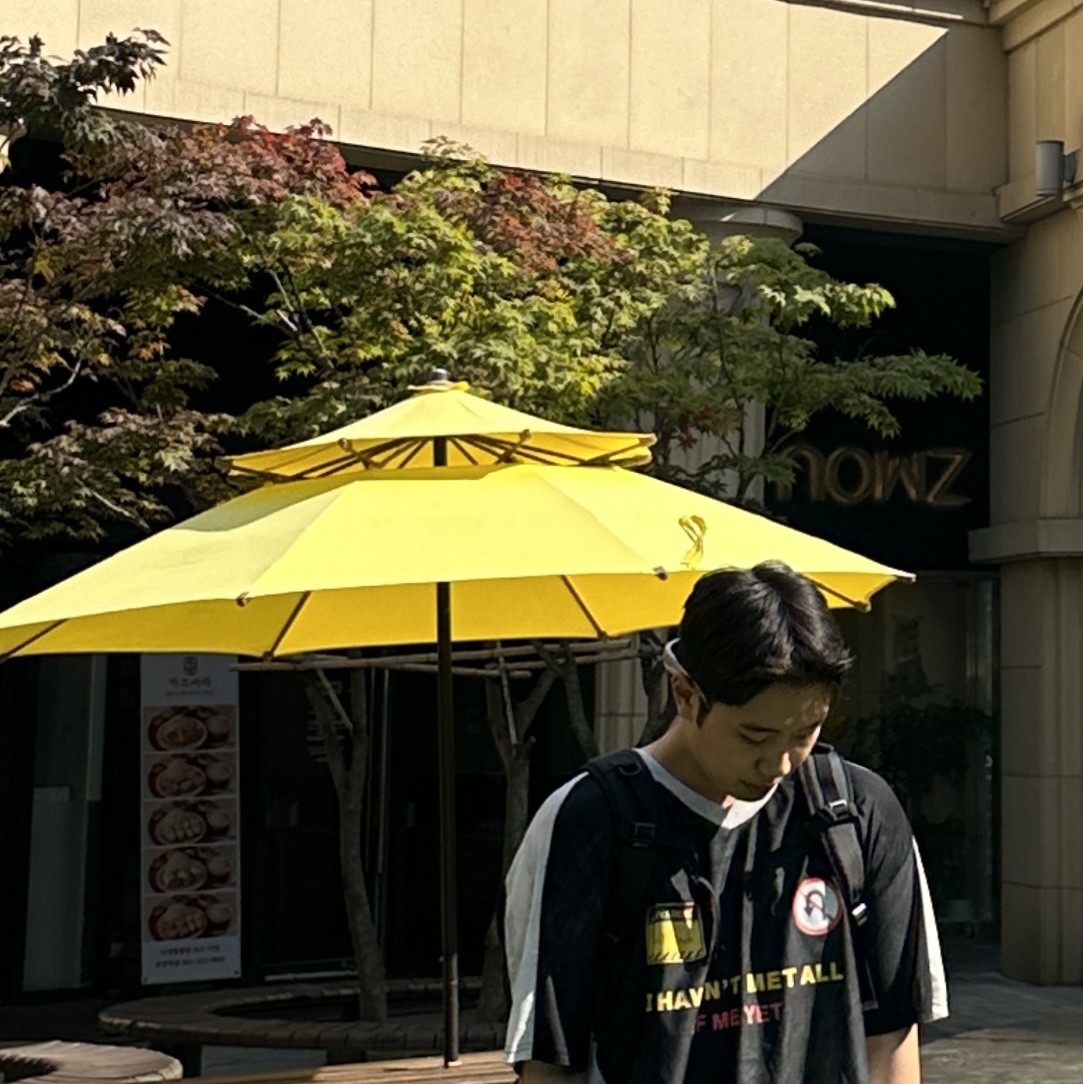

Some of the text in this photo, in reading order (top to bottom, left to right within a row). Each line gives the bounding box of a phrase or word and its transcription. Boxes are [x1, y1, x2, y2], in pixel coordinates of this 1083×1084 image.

[746, 966, 797, 994] MET
[800, 961, 845, 985] ALL
[712, 1008, 740, 1032] ME
[742, 1001, 783, 1025] YET
